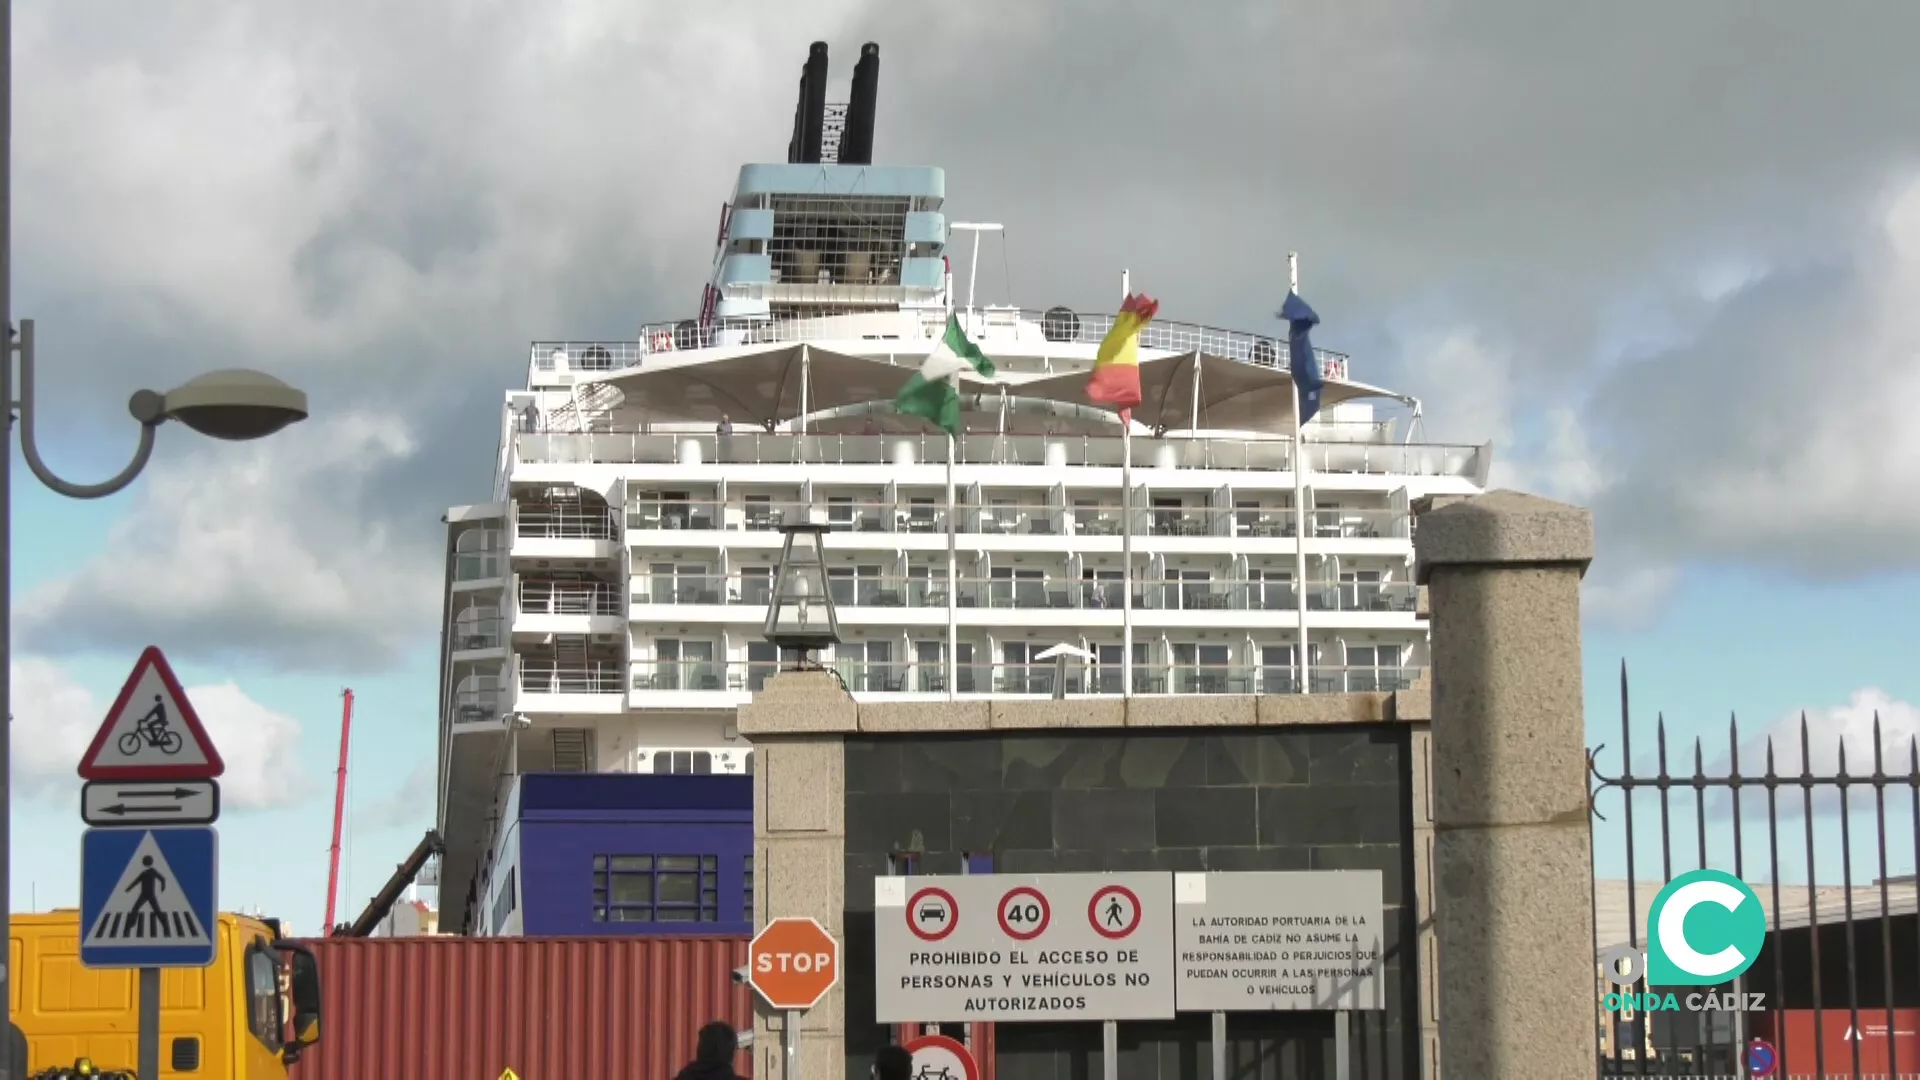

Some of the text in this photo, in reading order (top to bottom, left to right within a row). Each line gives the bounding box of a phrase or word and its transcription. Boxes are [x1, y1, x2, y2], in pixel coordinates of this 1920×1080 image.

[1007, 904, 1040, 923] 40
[1192, 915, 1366, 927] LA AUTORIDAD PORTUARIA DE LA
[1199, 933, 1230, 944] BAHÍA
[1234, 934, 1247, 944] DE
[1285, 933, 1301, 944] NO
[1305, 933, 1341, 943] ASUME
[1345, 933, 1359, 943] LA
[756, 952, 830, 973] STOP
[909, 950, 1139, 966] PROHIBIDO EL ACCESO DE
[1182, 950, 1378, 962] RESPONSABILIDAD O PERJUICIOS QUE
[901, 971, 1150, 989] PERSONAS Y VEHÍCULOS NO
[1186, 967, 1374, 979] PUEDAN OCURRIR A LAS PERSONAS
[1247, 983, 1316, 995] O VEHÍCULOS
[964, 996, 1086, 1012] AUTORIZADOS
